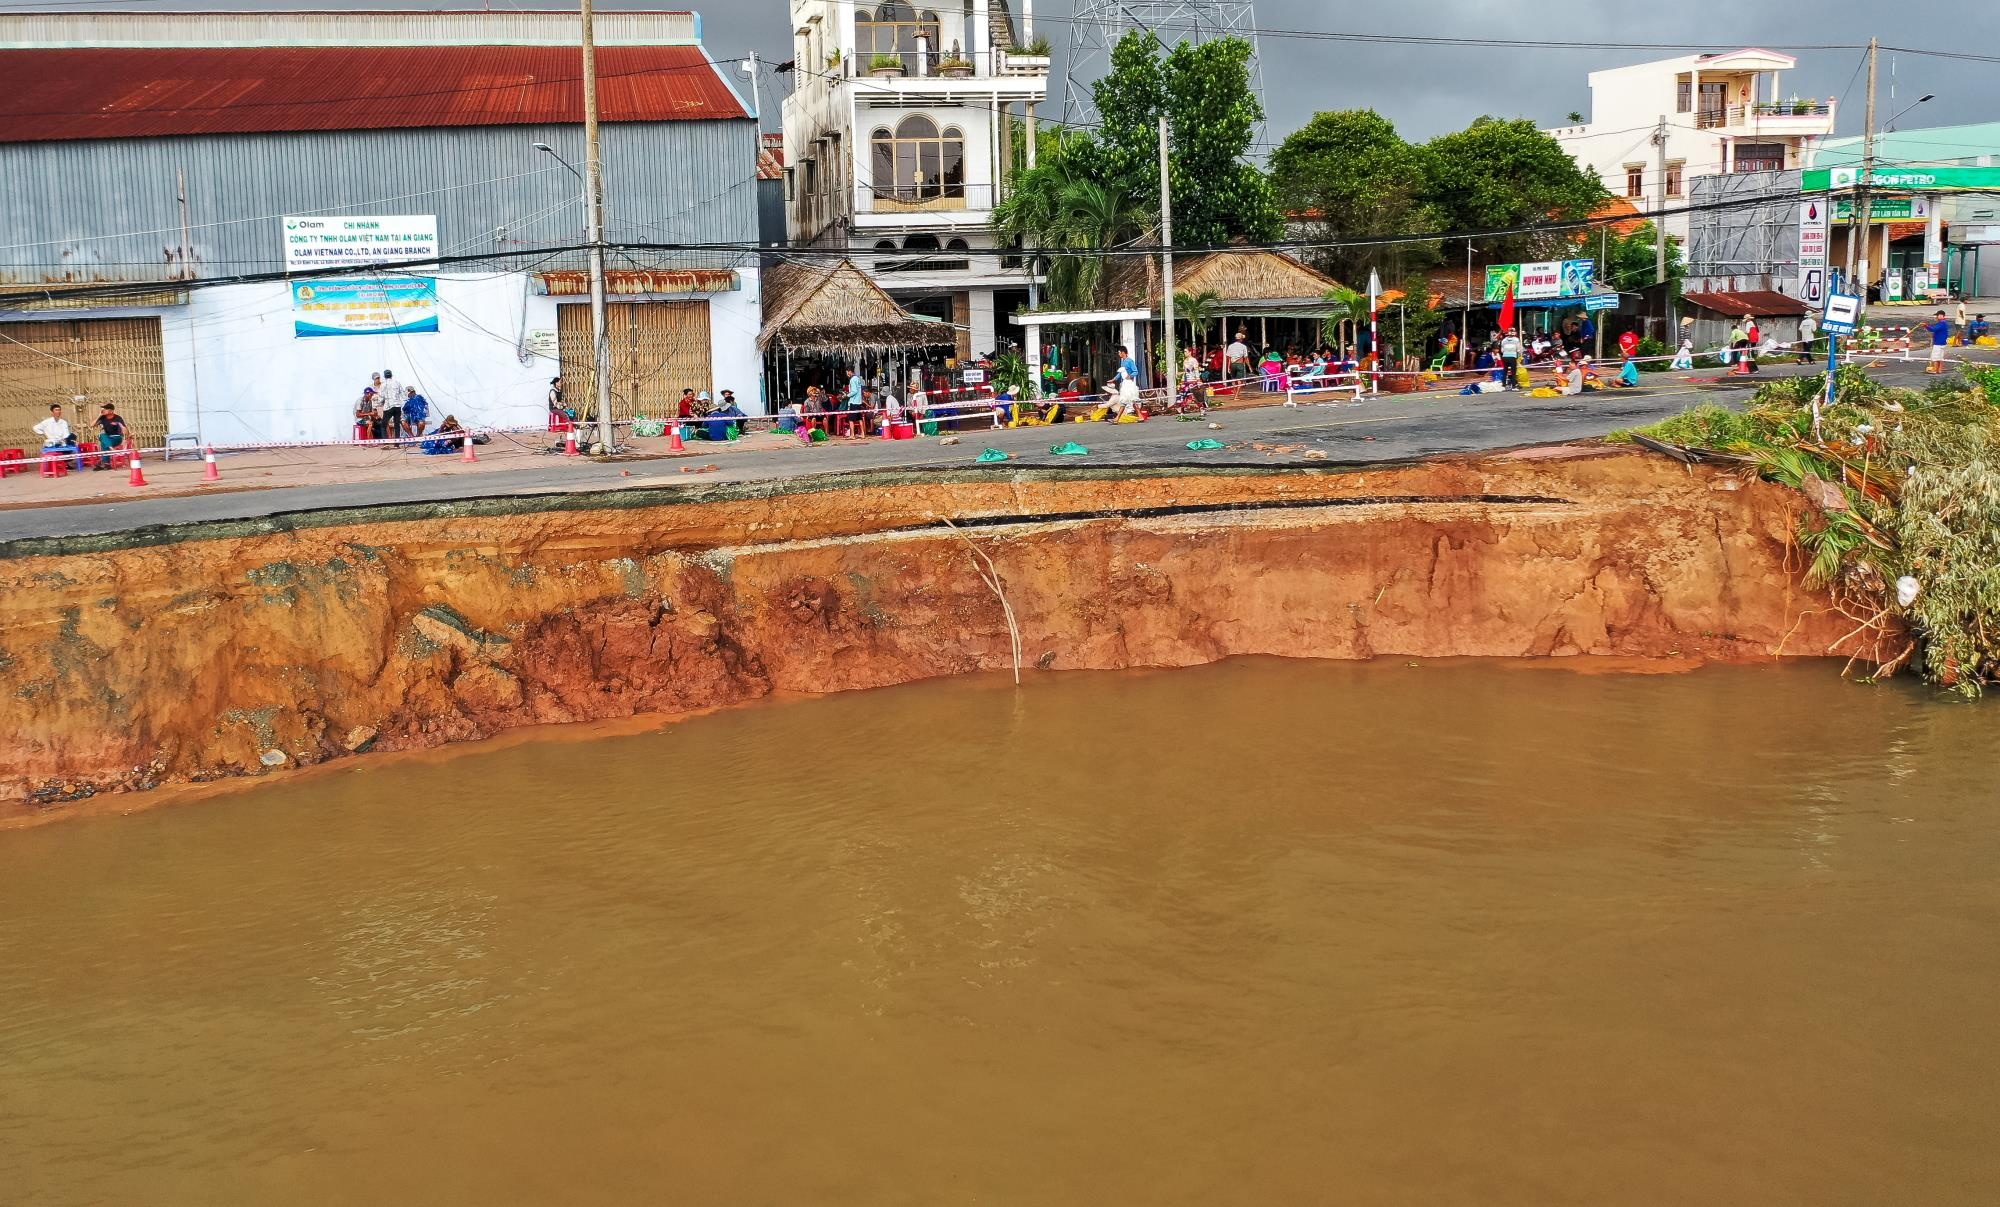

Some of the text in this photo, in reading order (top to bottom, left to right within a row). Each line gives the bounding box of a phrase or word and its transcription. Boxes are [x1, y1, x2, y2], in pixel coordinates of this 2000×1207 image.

[1901, 174, 1935, 185] PETRO
[319, 234, 338, 242] TNHH
[339, 234, 358, 242] OLAM
[374, 234, 389, 242] NAM
[402, 233, 412, 241] AN
[413, 233, 433, 241] GIANG
[294, 248, 313, 257] OLAM
[314, 248, 344, 256] VIETNAM
[372, 247, 382, 255] AN
[382, 246, 403, 255] GIANG
[404, 246, 431, 254] BRANCH
